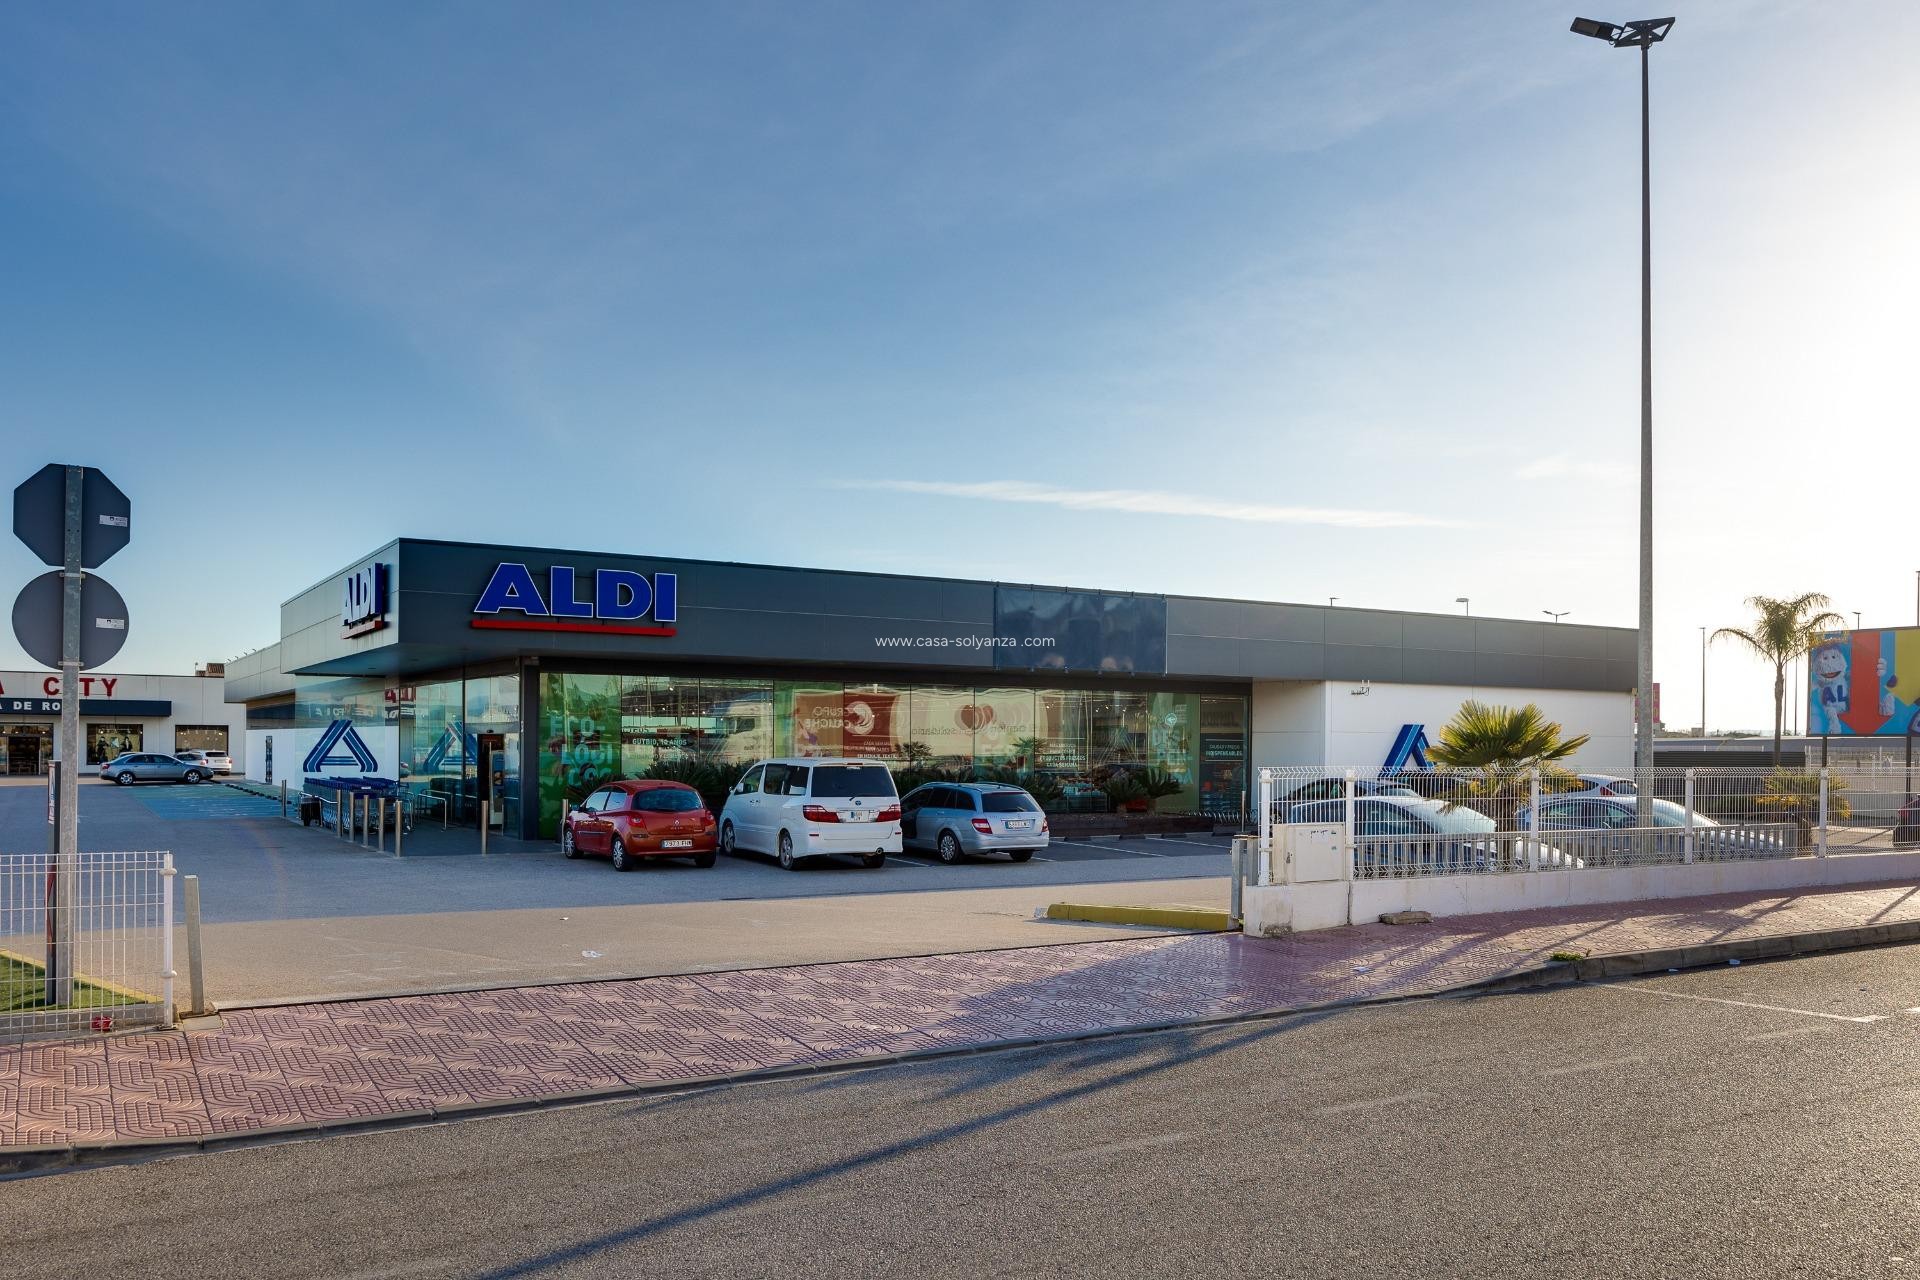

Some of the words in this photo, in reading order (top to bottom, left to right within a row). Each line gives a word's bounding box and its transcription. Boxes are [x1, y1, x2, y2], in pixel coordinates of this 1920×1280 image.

[341, 562, 384, 625] ALDI
[474, 562, 677, 622] ALDI
[13, 701, 32, 710] DE
[43, 676, 118, 697] CTY
